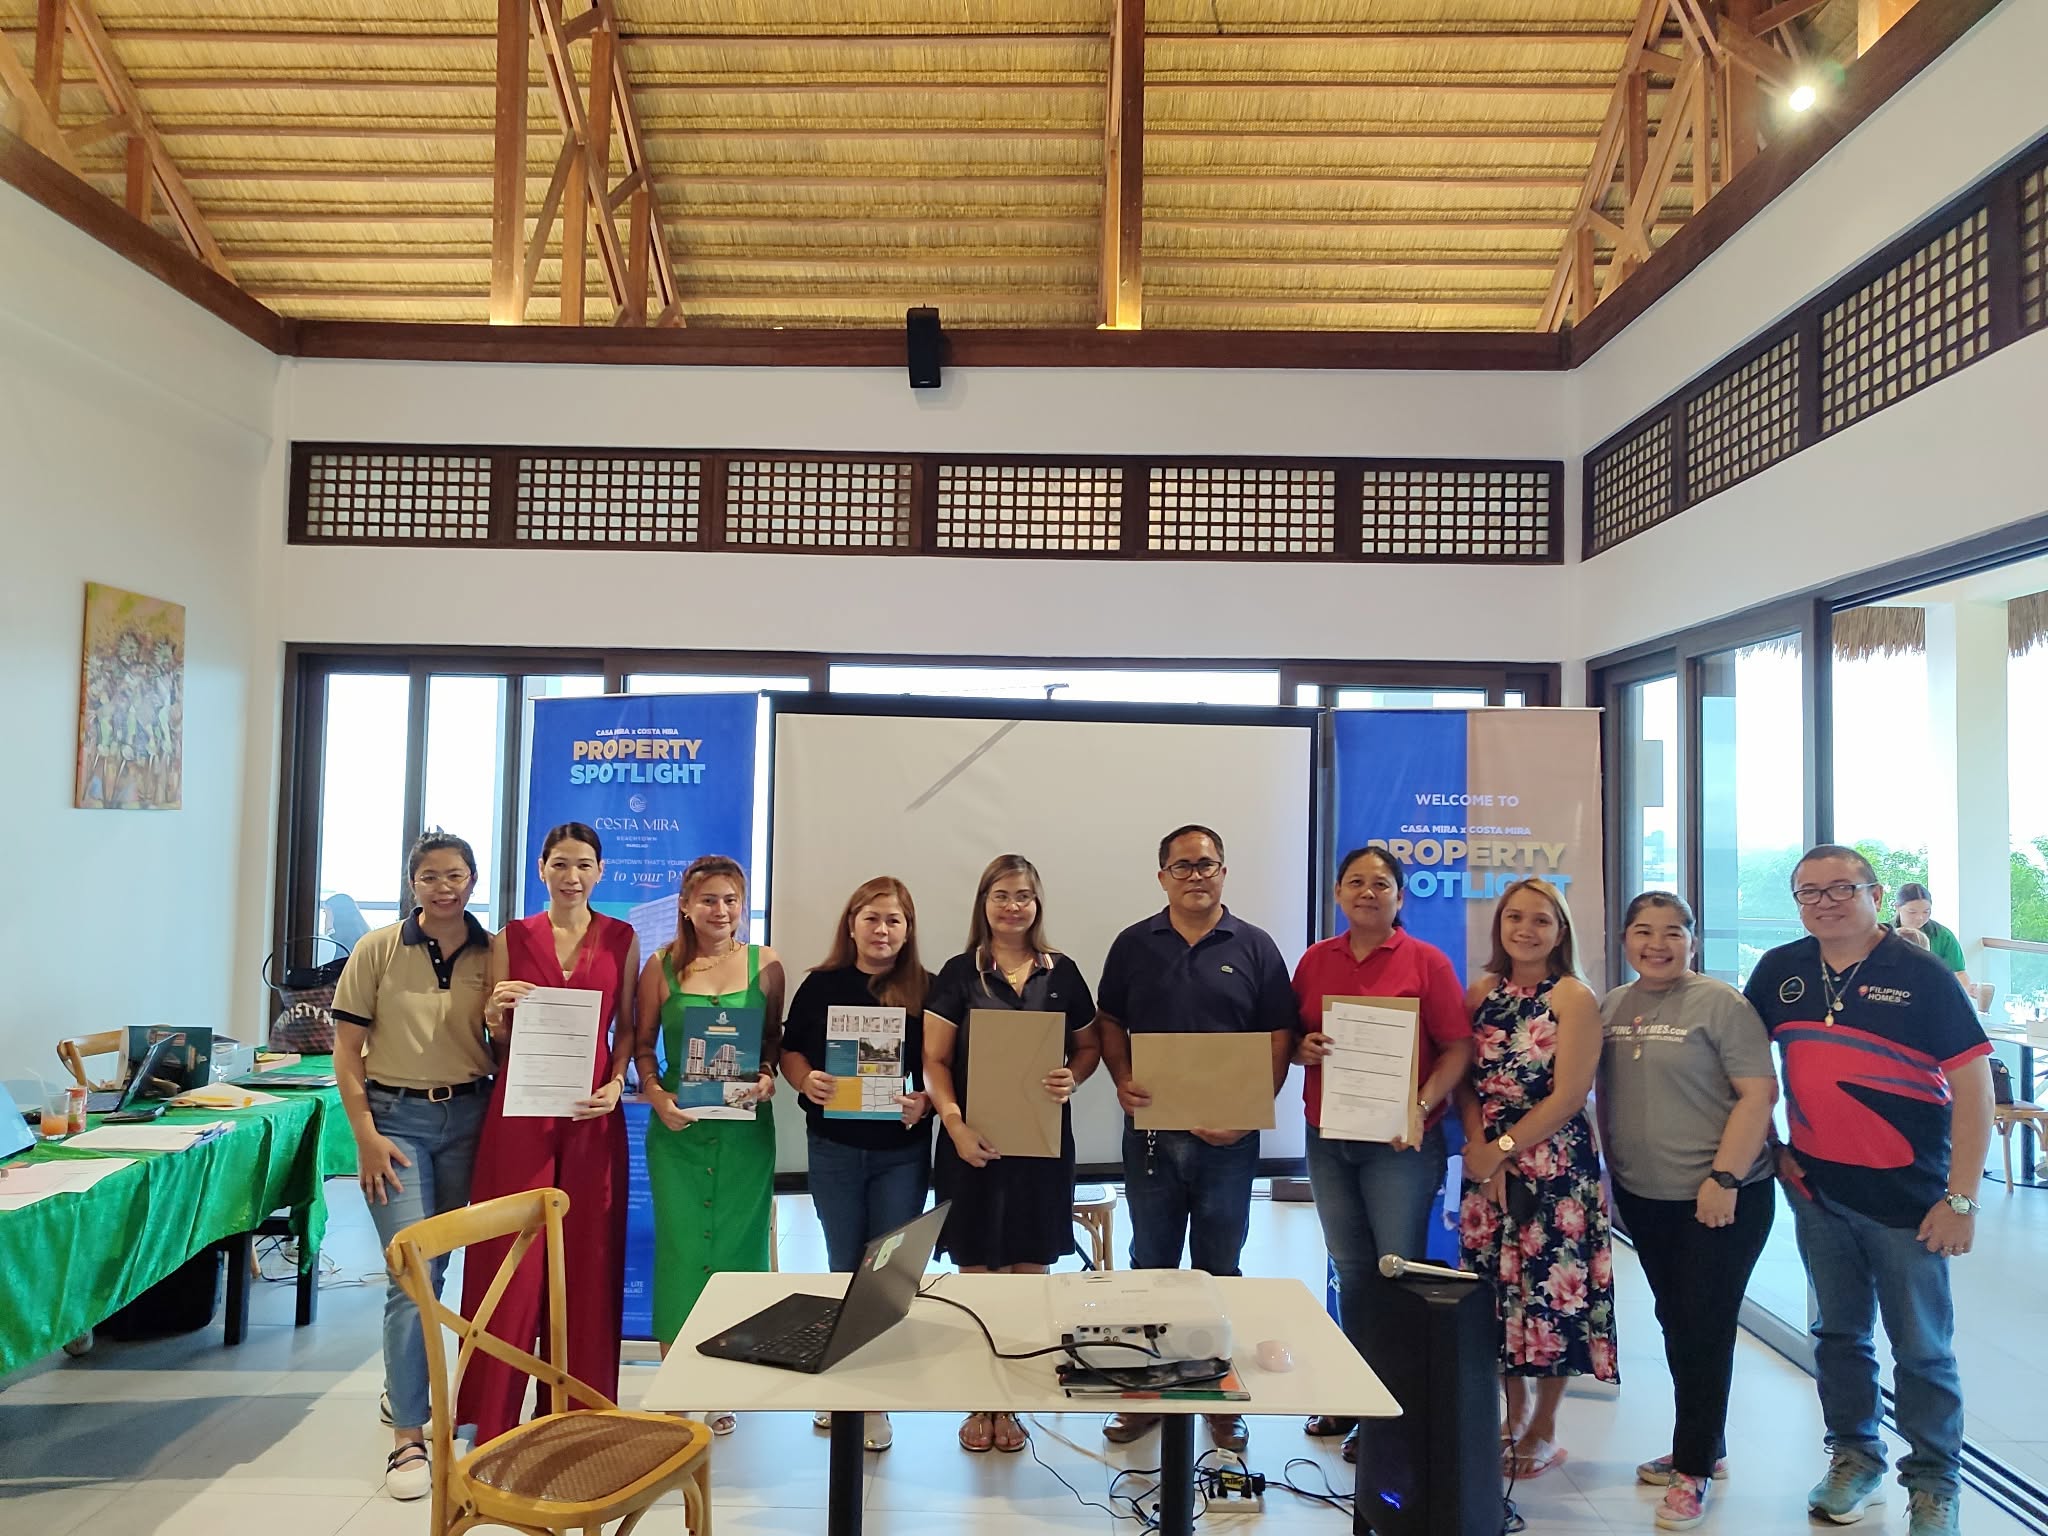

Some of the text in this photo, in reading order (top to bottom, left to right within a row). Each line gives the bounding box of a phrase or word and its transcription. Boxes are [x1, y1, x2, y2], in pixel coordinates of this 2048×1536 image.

[573, 739, 702, 761] PROPERTY
[569, 763, 706, 785] SPOTLIGHT
[1416, 794, 1520, 808] WELCOME TO
[595, 817, 680, 832] COSTA MIRA
[1400, 825, 1431, 834] CASA
[1432, 825, 1458, 834] MIRA
[1469, 826, 1503, 835] COSTA
[1505, 827, 1532, 836] MIRA
[605, 858, 643, 866] EACHTOWN
[613, 870, 627, 883] to
[629, 871, 664, 886] your
[1867, 993, 1901, 1003] HOMES
[1868, 986, 1911, 999] FILIPINO
